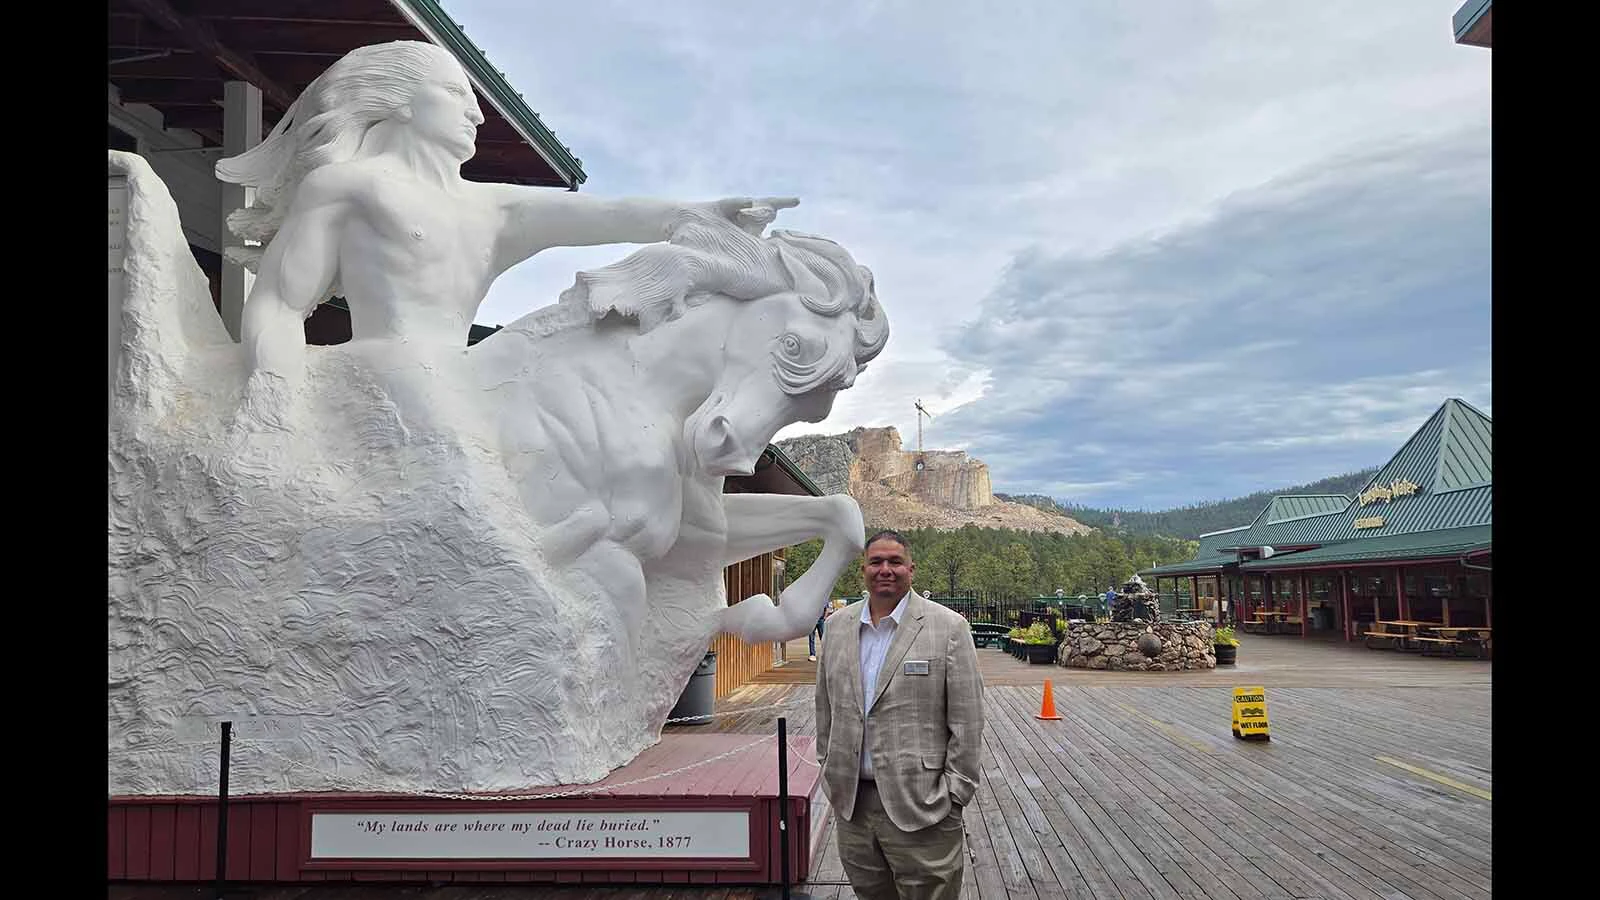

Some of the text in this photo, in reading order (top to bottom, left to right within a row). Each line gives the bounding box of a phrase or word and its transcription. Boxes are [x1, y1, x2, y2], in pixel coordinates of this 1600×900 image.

[391, 820, 430, 832] lands
[435, 822, 458, 832] are
[463, 820, 505, 832] where
[511, 822, 531, 834] my
[537, 819, 570, 831] dead
[576, 819, 594, 831] lie
[555, 836, 599, 851] Crazy
[605, 836, 652, 849] Horse,
[659, 836, 692, 848] 1877
